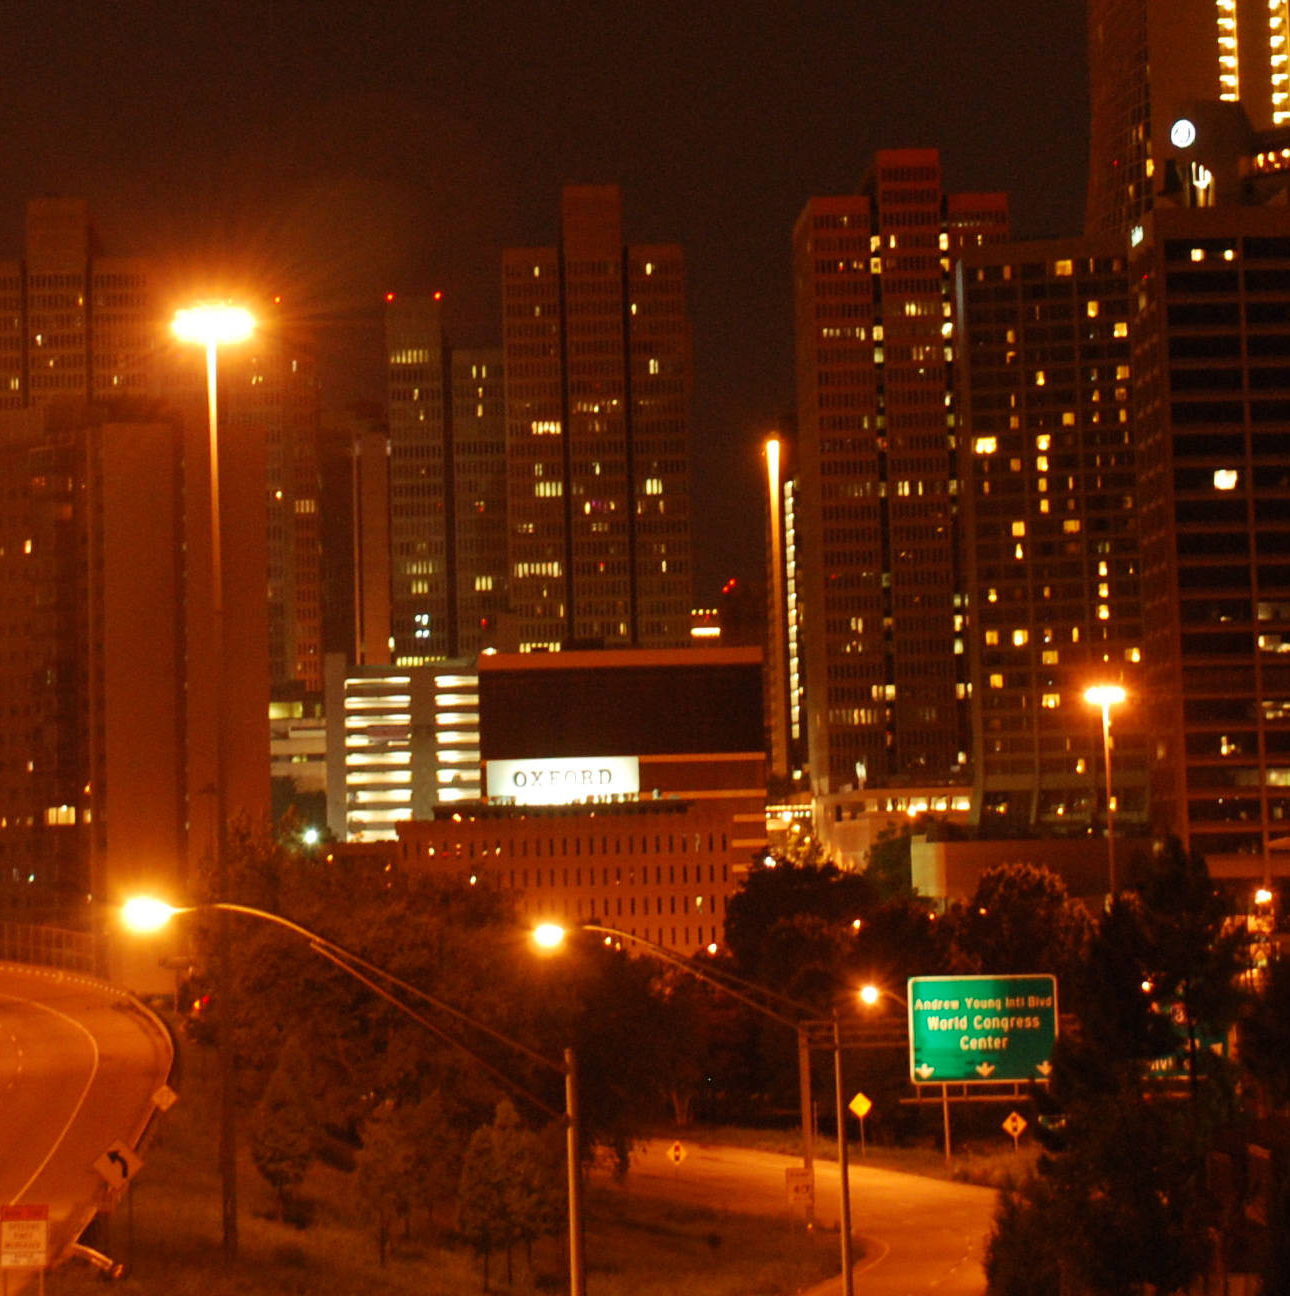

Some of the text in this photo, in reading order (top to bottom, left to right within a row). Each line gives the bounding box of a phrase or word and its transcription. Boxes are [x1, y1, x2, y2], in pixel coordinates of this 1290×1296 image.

[512, 768, 613, 788] OXFORD
[914, 998, 960, 1010] Andrew
[964, 997, 1002, 1011] Young
[1027, 996, 1053, 1008] Blvd
[927, 1015, 1041, 1033] World Congress
[959, 1035, 1009, 1051] Center
